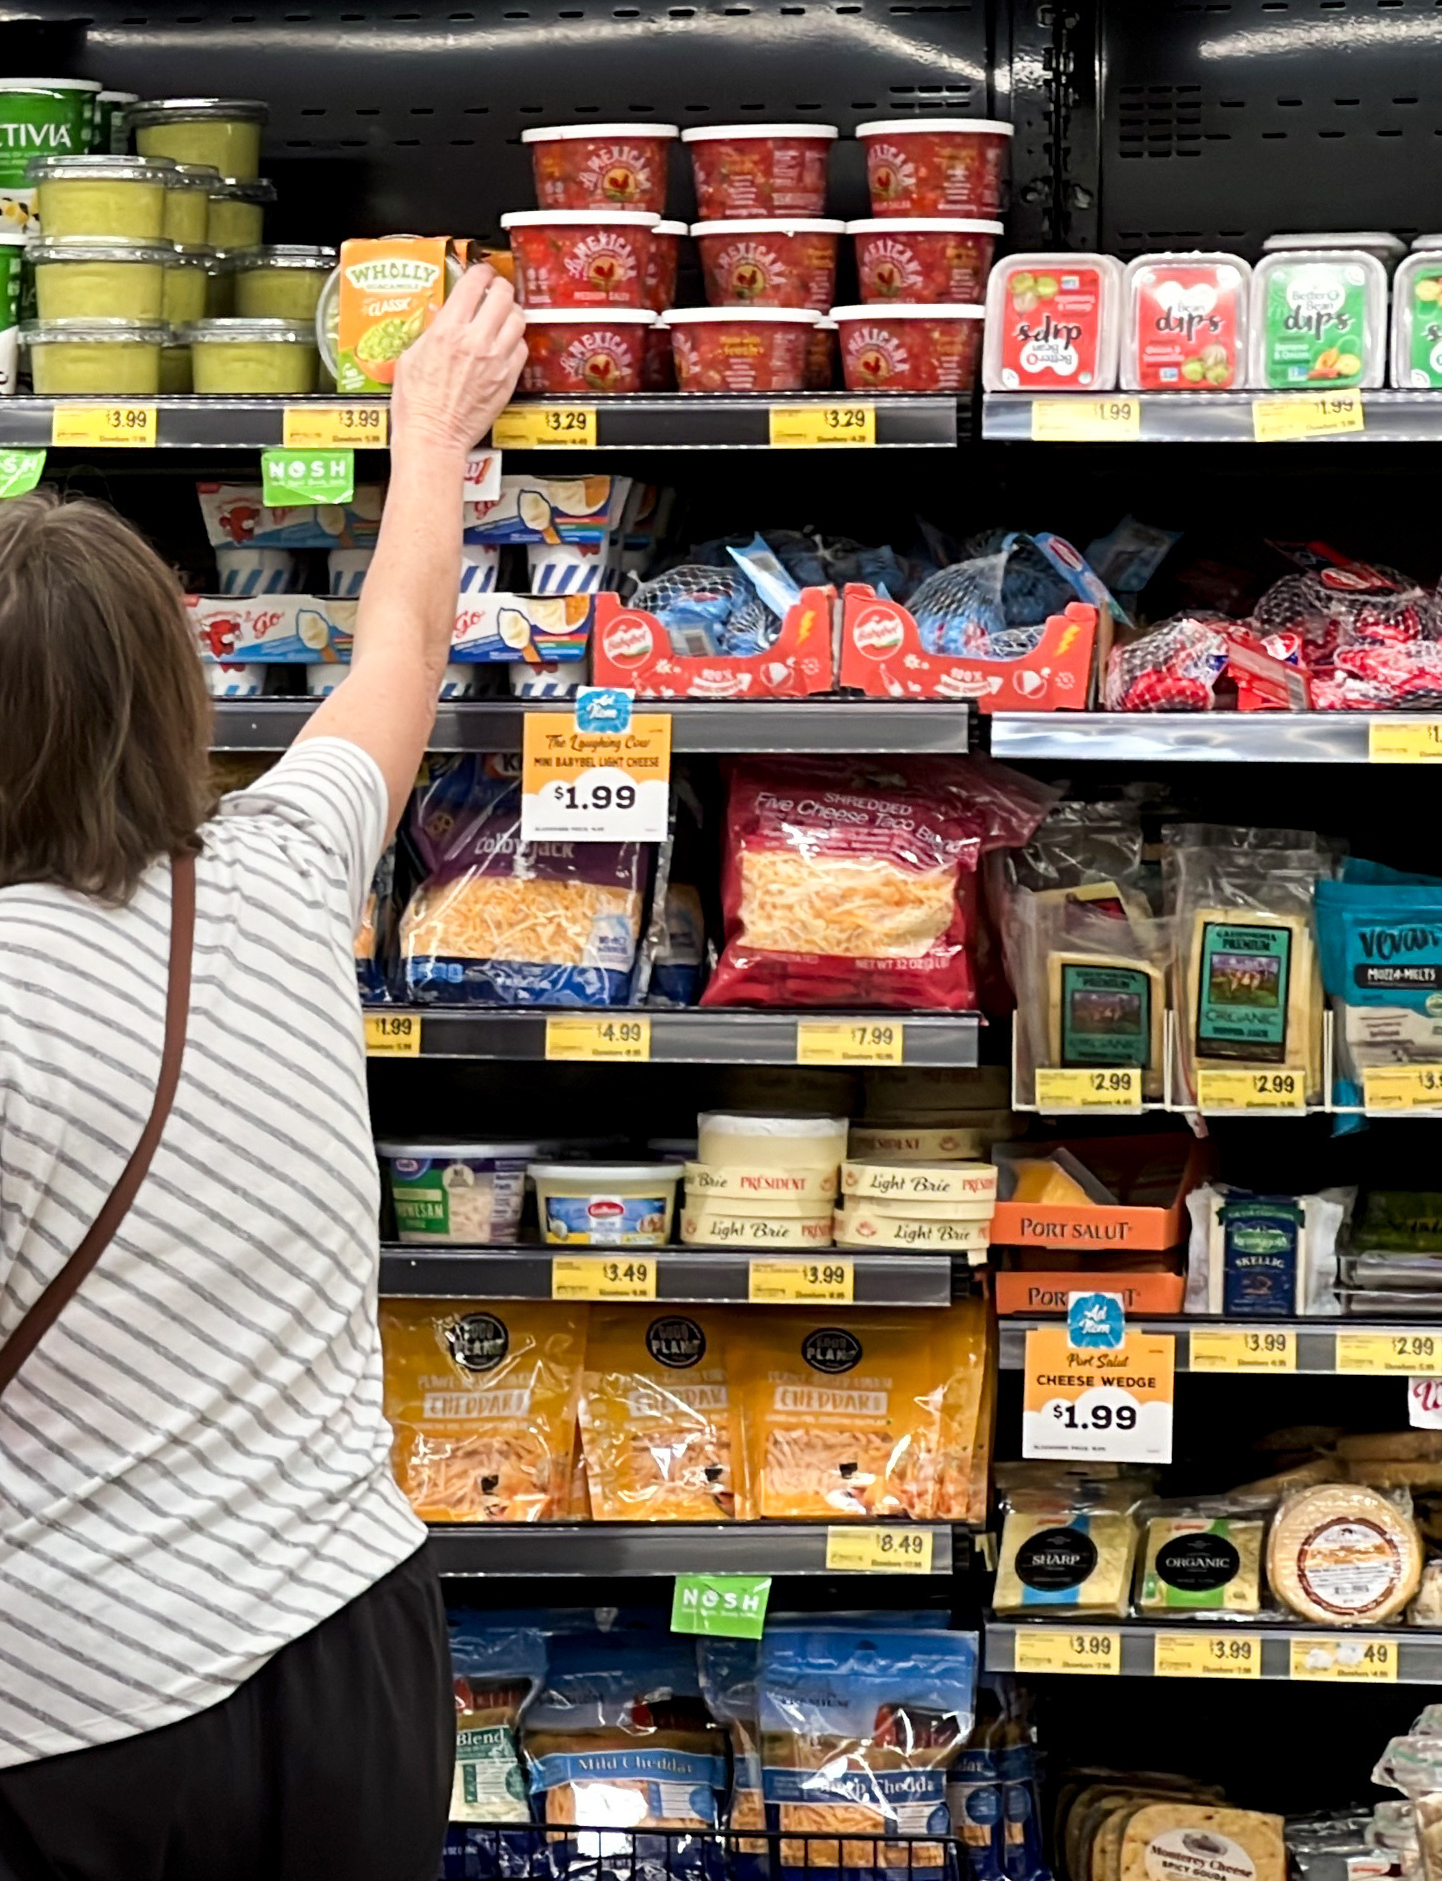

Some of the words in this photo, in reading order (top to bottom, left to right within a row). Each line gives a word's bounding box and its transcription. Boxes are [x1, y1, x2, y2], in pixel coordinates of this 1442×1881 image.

[351, 264, 436, 285] WHOLLY
[1283, 305, 1354, 340] dips
[269, 462, 346, 478] NOSH
[546, 734, 565, 750] The
[569, 734, 620, 754] Laughing
[624, 735, 651, 749] Cow
[534, 757, 552, 768] MINI
[555, 757, 595, 768] BABYBEL
[599, 757, 623, 768] LIGHT
[625, 757, 660, 768] CHEESE
[553, 785, 636, 810] $1.99
[824, 792, 912, 816] SHREDDED
[755, 792, 792, 813] Five
[798, 799, 868, 825] Cheese
[874, 812, 915, 831] Taco
[870, 1172, 906, 1194] Light
[912, 1173, 951, 1193] Brie
[710, 1220, 745, 1241] Light
[751, 1219, 789, 1239] Brie
[894, 1223, 932, 1244] Light
[938, 1224, 970, 1243] Brie
[1021, 1218, 1069, 1237] PORT
[1072, 1220, 1128, 1240] SALUT
[1235, 1256, 1285, 1268] SKELLIG
[1029, 1287, 1068, 1305] POR
[1067, 1352, 1093, 1369] Port
[1097, 1353, 1128, 1368] Salut
[1037, 1375, 1095, 1387] CHEESE
[1102, 1375, 1156, 1388] WEDGE
[1053, 1404, 1136, 1430] $1.99
[1032, 1555, 1079, 1565] SHARP
[1166, 1557, 1229, 1569] ORGANIC
[683, 1589, 758, 1610] NOSH
[456, 1730, 503, 1747] Blend
[578, 1756, 614, 1772] Mild
[1150, 1844, 1210, 1868] Monterey
[1209, 1860, 1253, 1878] Cheese
